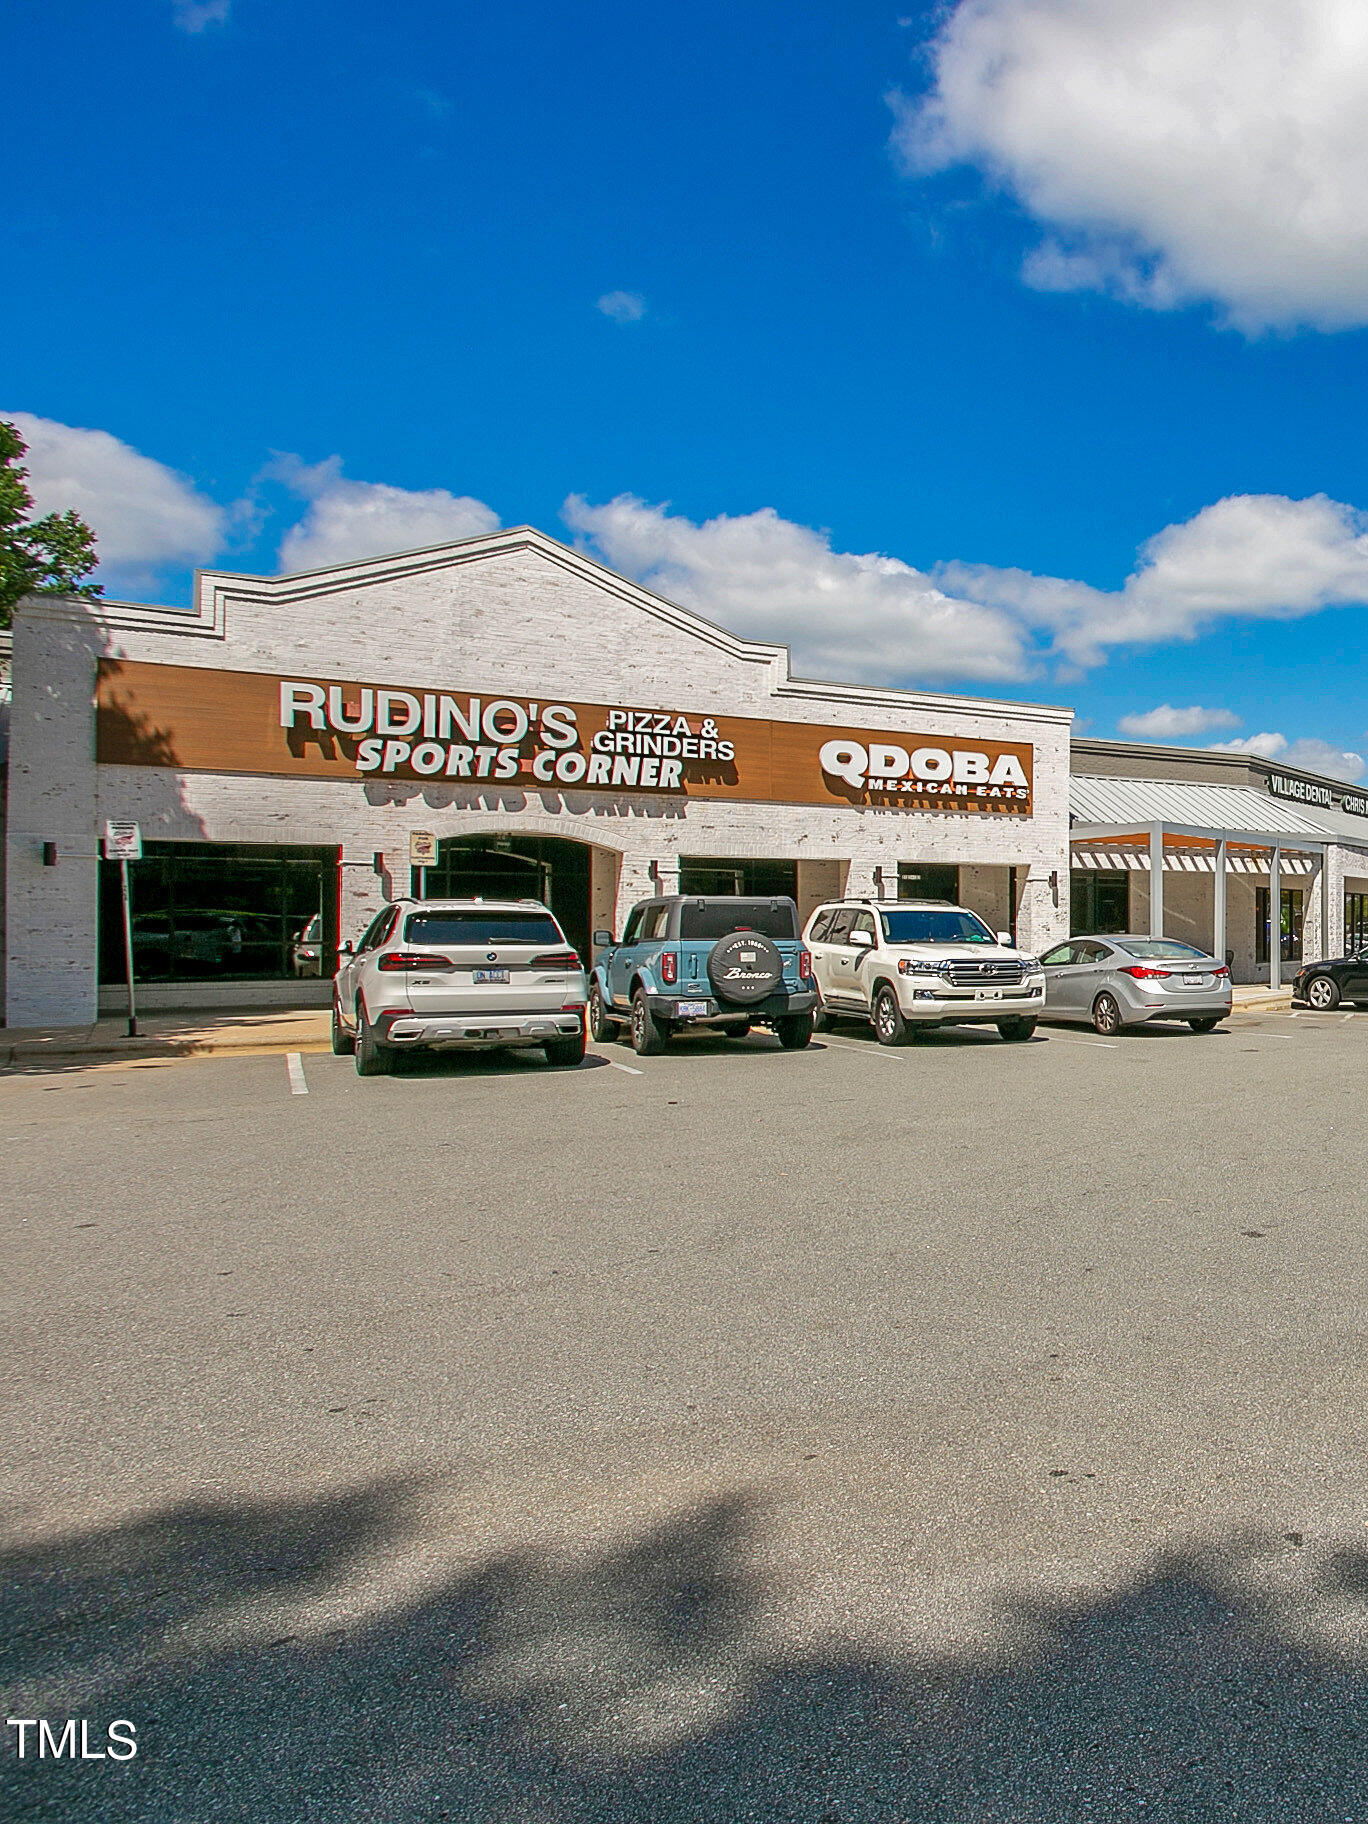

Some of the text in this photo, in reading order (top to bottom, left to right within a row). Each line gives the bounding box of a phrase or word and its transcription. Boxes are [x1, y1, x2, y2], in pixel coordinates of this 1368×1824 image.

[279, 681, 577, 749] RUDINO'S
[607, 709, 719, 739] PIZZA &
[592, 731, 735, 761] GRINDERS
[355, 738, 684, 788] SPORTS CORNER
[819, 739, 1029, 788] QDOBA
[868, 778, 968, 796] MEXICAN
[1271, 774, 1333, 806] VILLAGE DENTAL
[1345, 795, 1365, 814] CHRIS
[723, 967, 773, 980] Bronco
